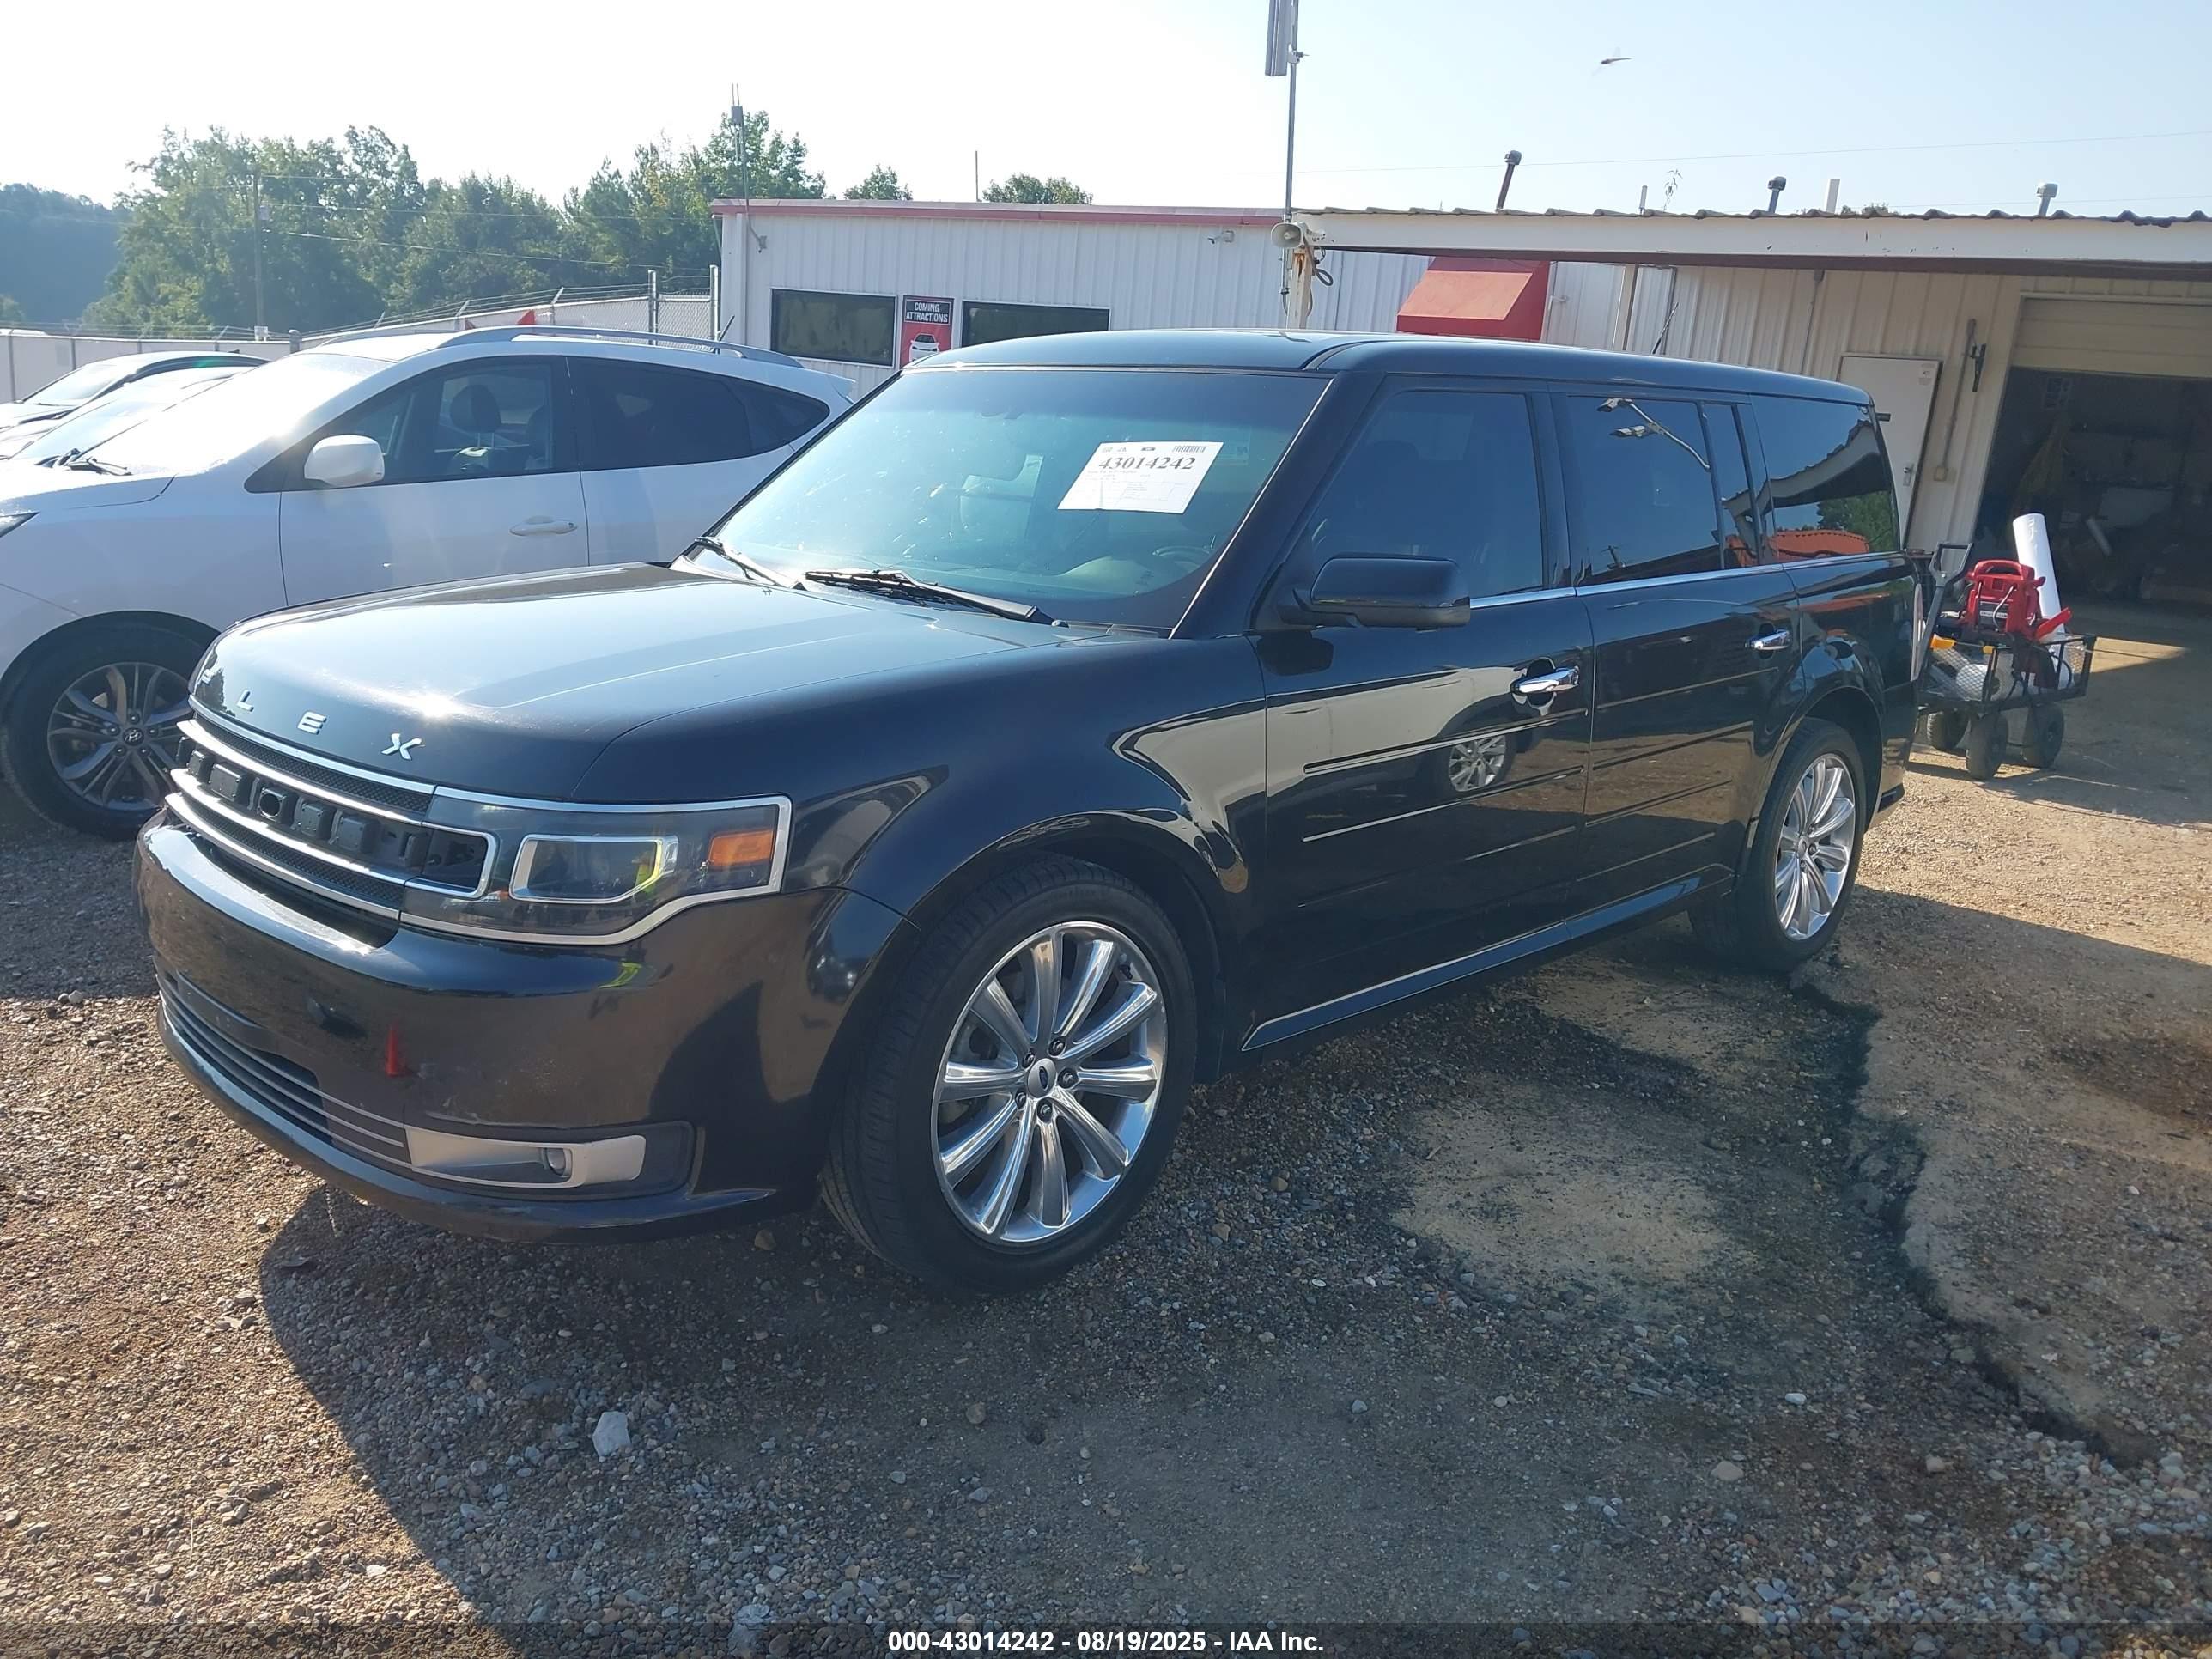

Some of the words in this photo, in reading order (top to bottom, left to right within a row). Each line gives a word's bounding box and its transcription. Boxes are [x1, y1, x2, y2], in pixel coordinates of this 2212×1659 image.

[914, 302, 940, 313] COMING
[906, 312, 948, 323] ATTRACTIONS
[1098, 457, 1196, 470] 43014242
